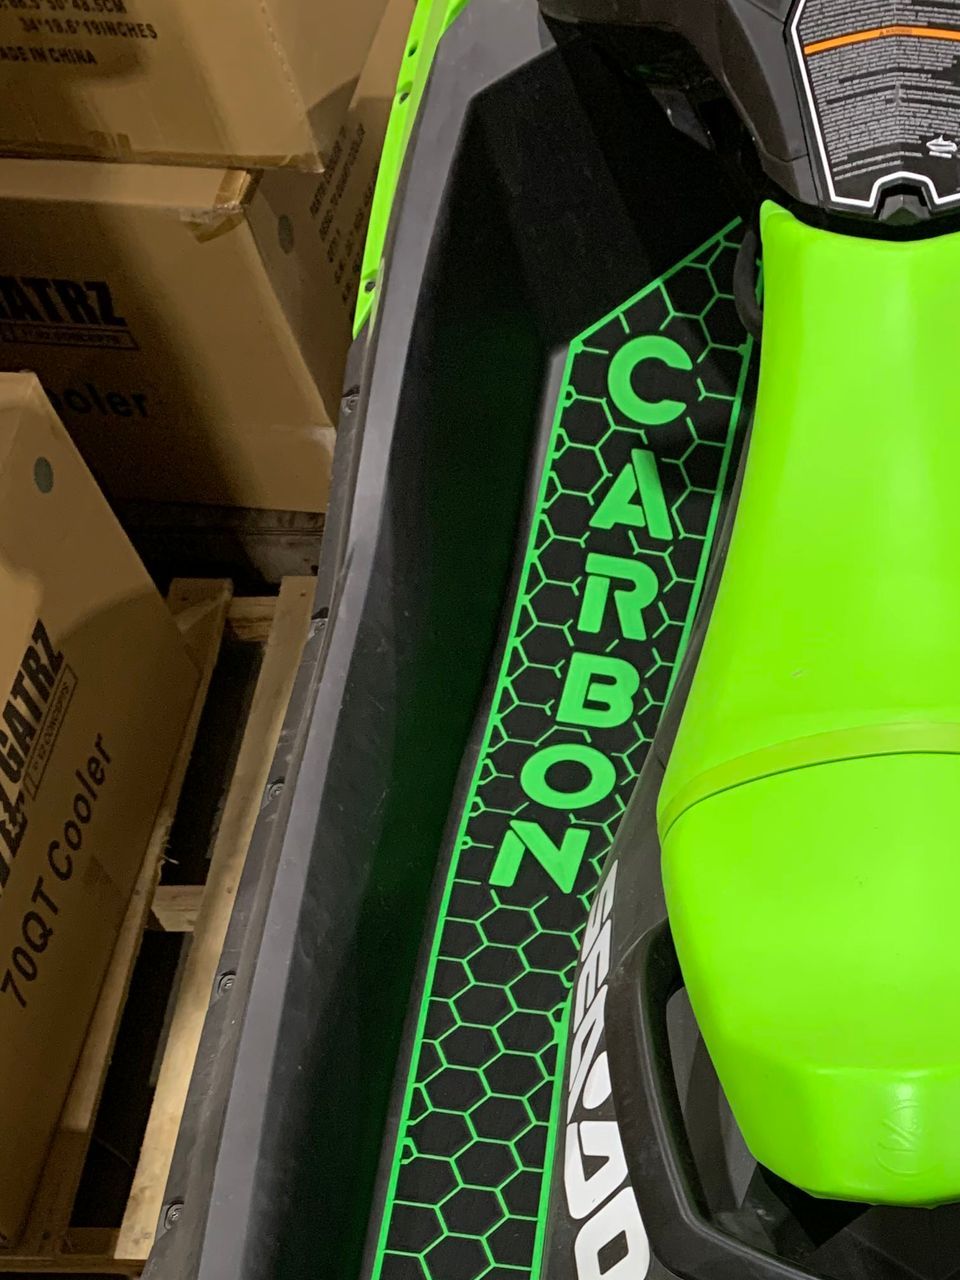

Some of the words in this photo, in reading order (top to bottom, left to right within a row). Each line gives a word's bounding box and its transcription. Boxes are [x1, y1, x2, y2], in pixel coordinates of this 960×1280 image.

[49, 48, 98, 64] CHINA
[489, 335, 693, 893] CARBON
[0, 875, 59, 1008] 70QT
[48, 733, 111, 881] Cooler
